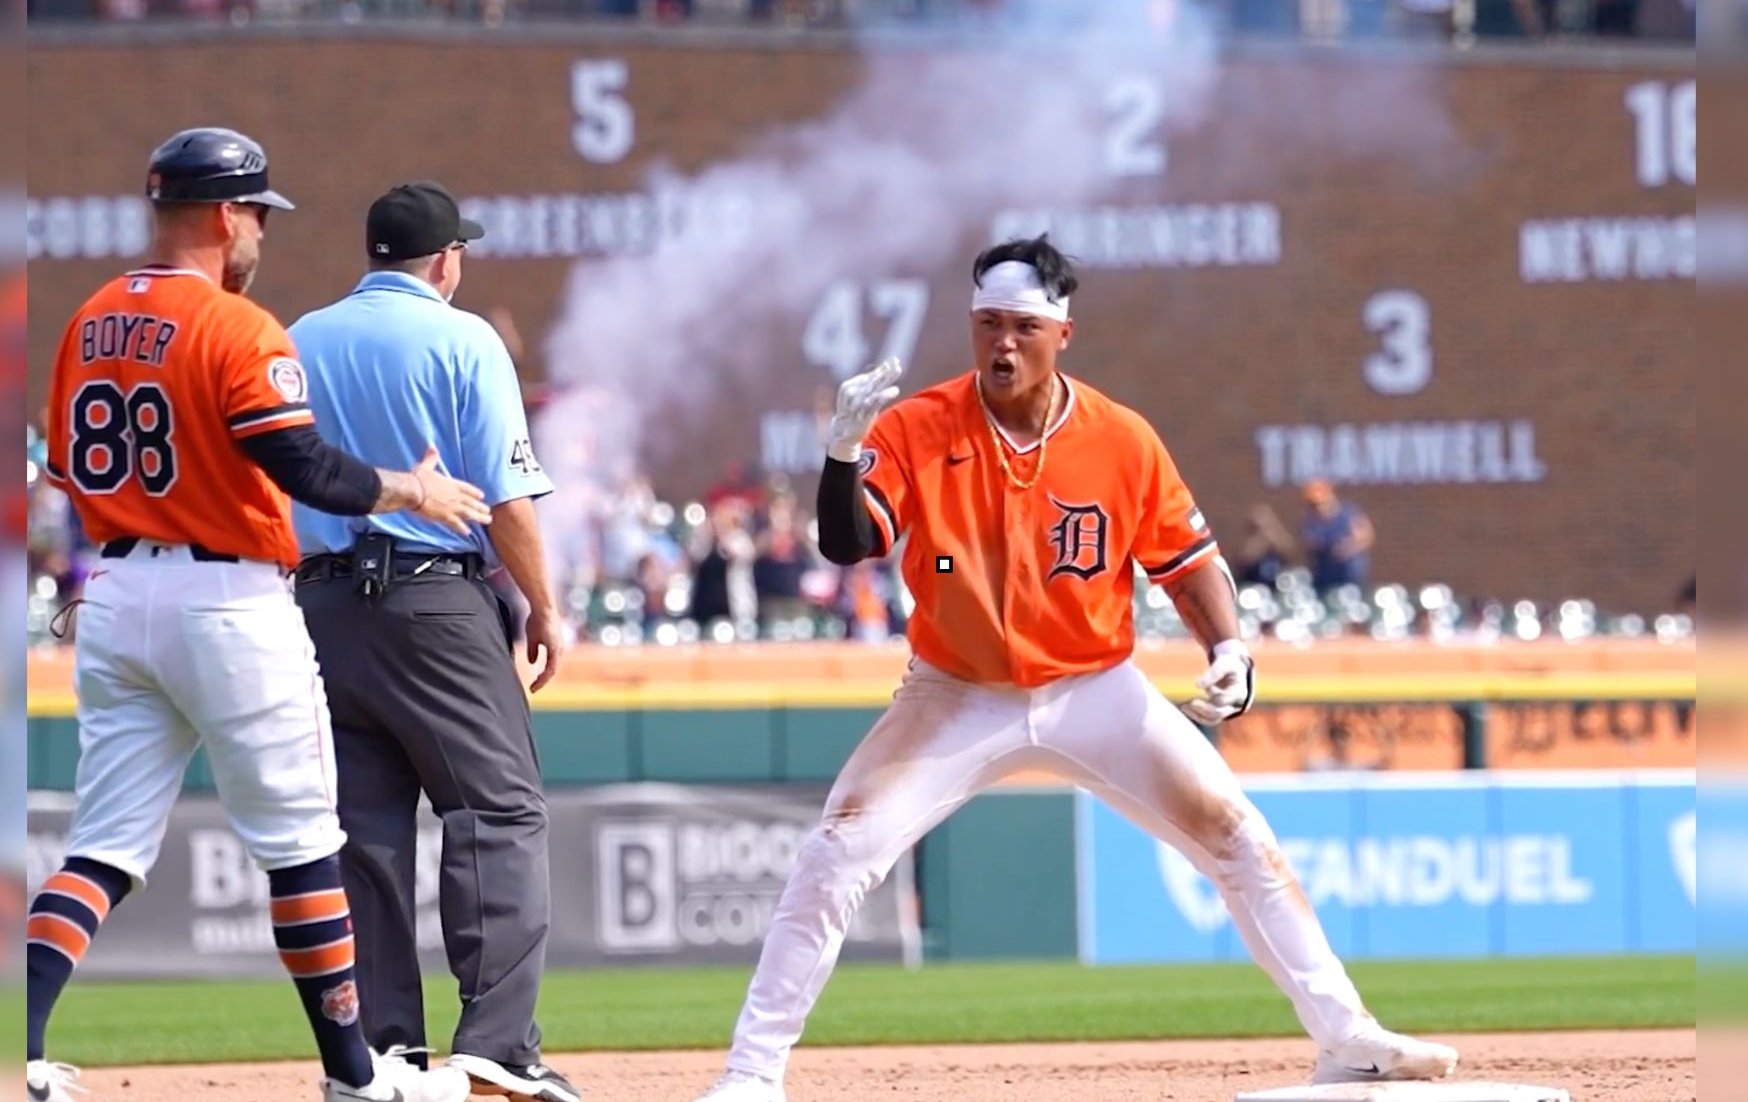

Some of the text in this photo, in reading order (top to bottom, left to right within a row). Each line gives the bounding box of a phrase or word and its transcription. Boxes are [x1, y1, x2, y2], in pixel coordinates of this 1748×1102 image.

[571, 60, 635, 163] 5
[1103, 77, 1166, 175] 2
[82, 314, 177, 367] BOYER
[803, 278, 929, 380] 47
[1364, 291, 1432, 394] 3
[69, 380, 178, 498] 88
[1255, 420, 1546, 487] TRAMMELL
